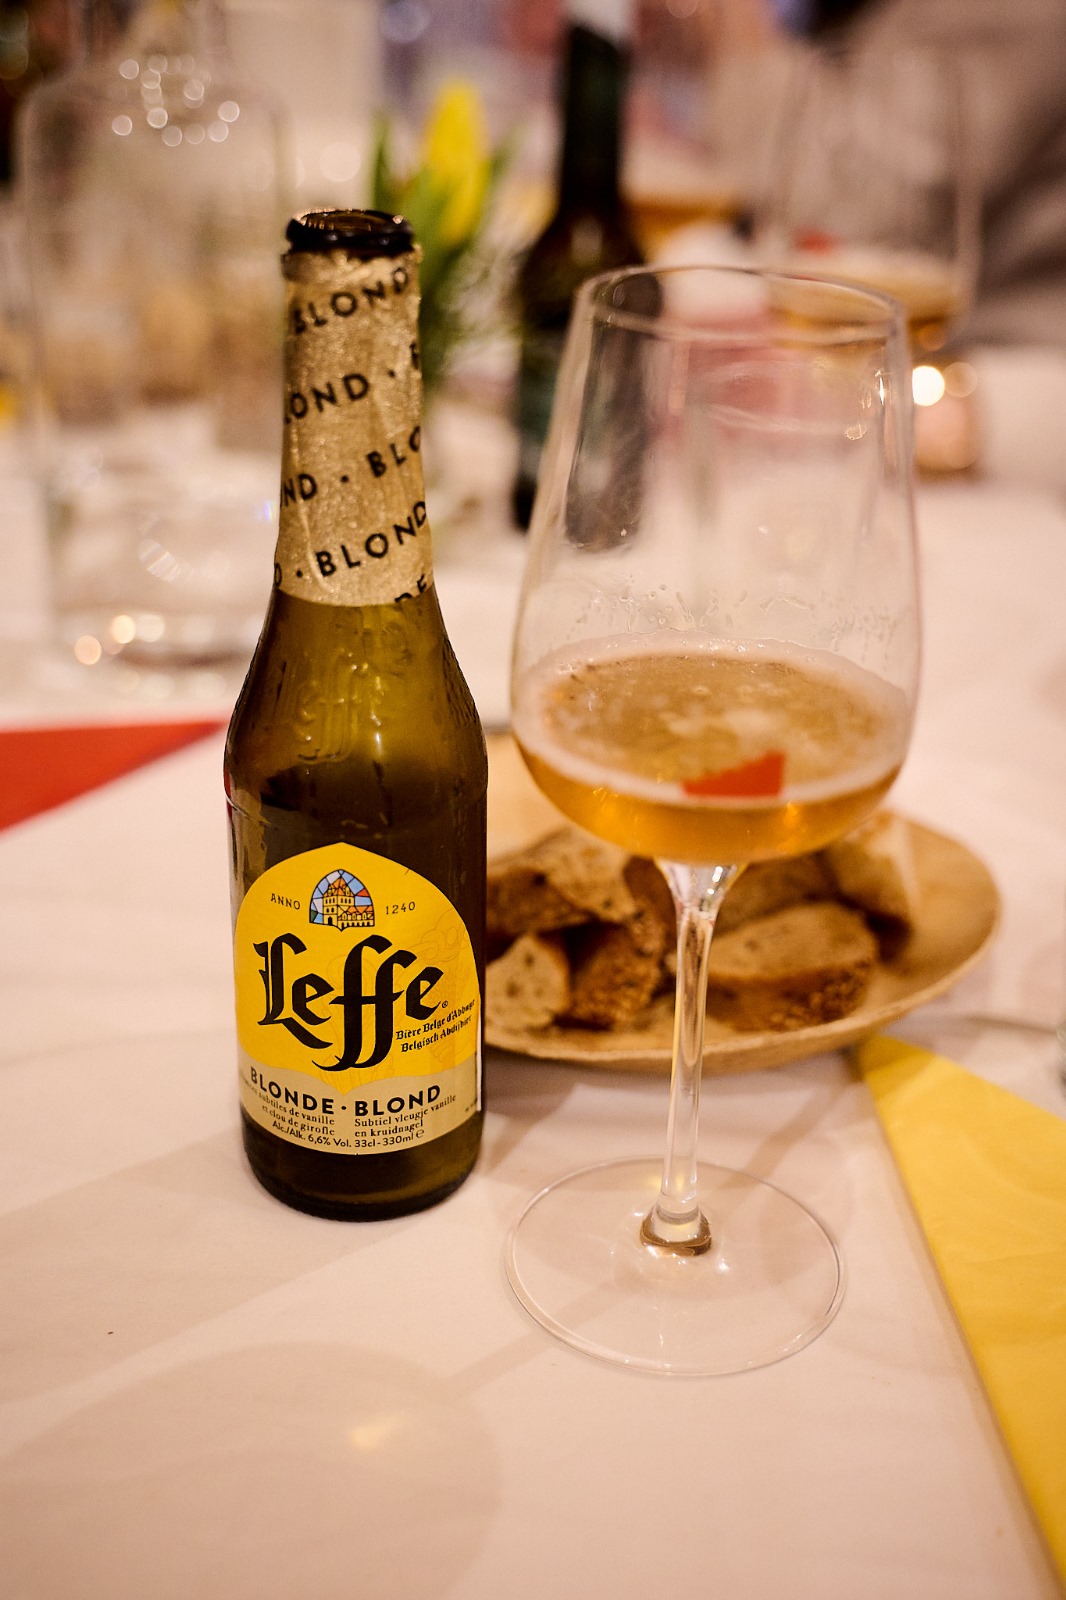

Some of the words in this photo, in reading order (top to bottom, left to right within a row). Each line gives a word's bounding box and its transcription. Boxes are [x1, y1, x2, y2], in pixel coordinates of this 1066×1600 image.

[270, 892, 301, 911] ANNO
[385, 901, 416, 915] 1240
[253, 932, 444, 1072] Leffe
[401, 1032, 439, 1053] Belgisch
[250, 1066, 334, 1115] BLONDE
[355, 1085, 441, 1117] BLOND
[289, 1107, 300, 1117] de
[301, 1112, 335, 1126] vanille
[354, 1117, 392, 1127] Subtiel
[395, 1109, 428, 1123] vleugje
[431, 1095, 456, 1112] vanille
[269, 1109, 286, 1122] clou
[288, 1117, 299, 1128] de
[300, 1122, 335, 1136] girofle
[354, 1130, 366, 1138] en
[370, 1119, 423, 1137] kruidnagel
[308, 1134, 331, 1146] 6,6%
[333, 1138, 352, 1148] Vol.
